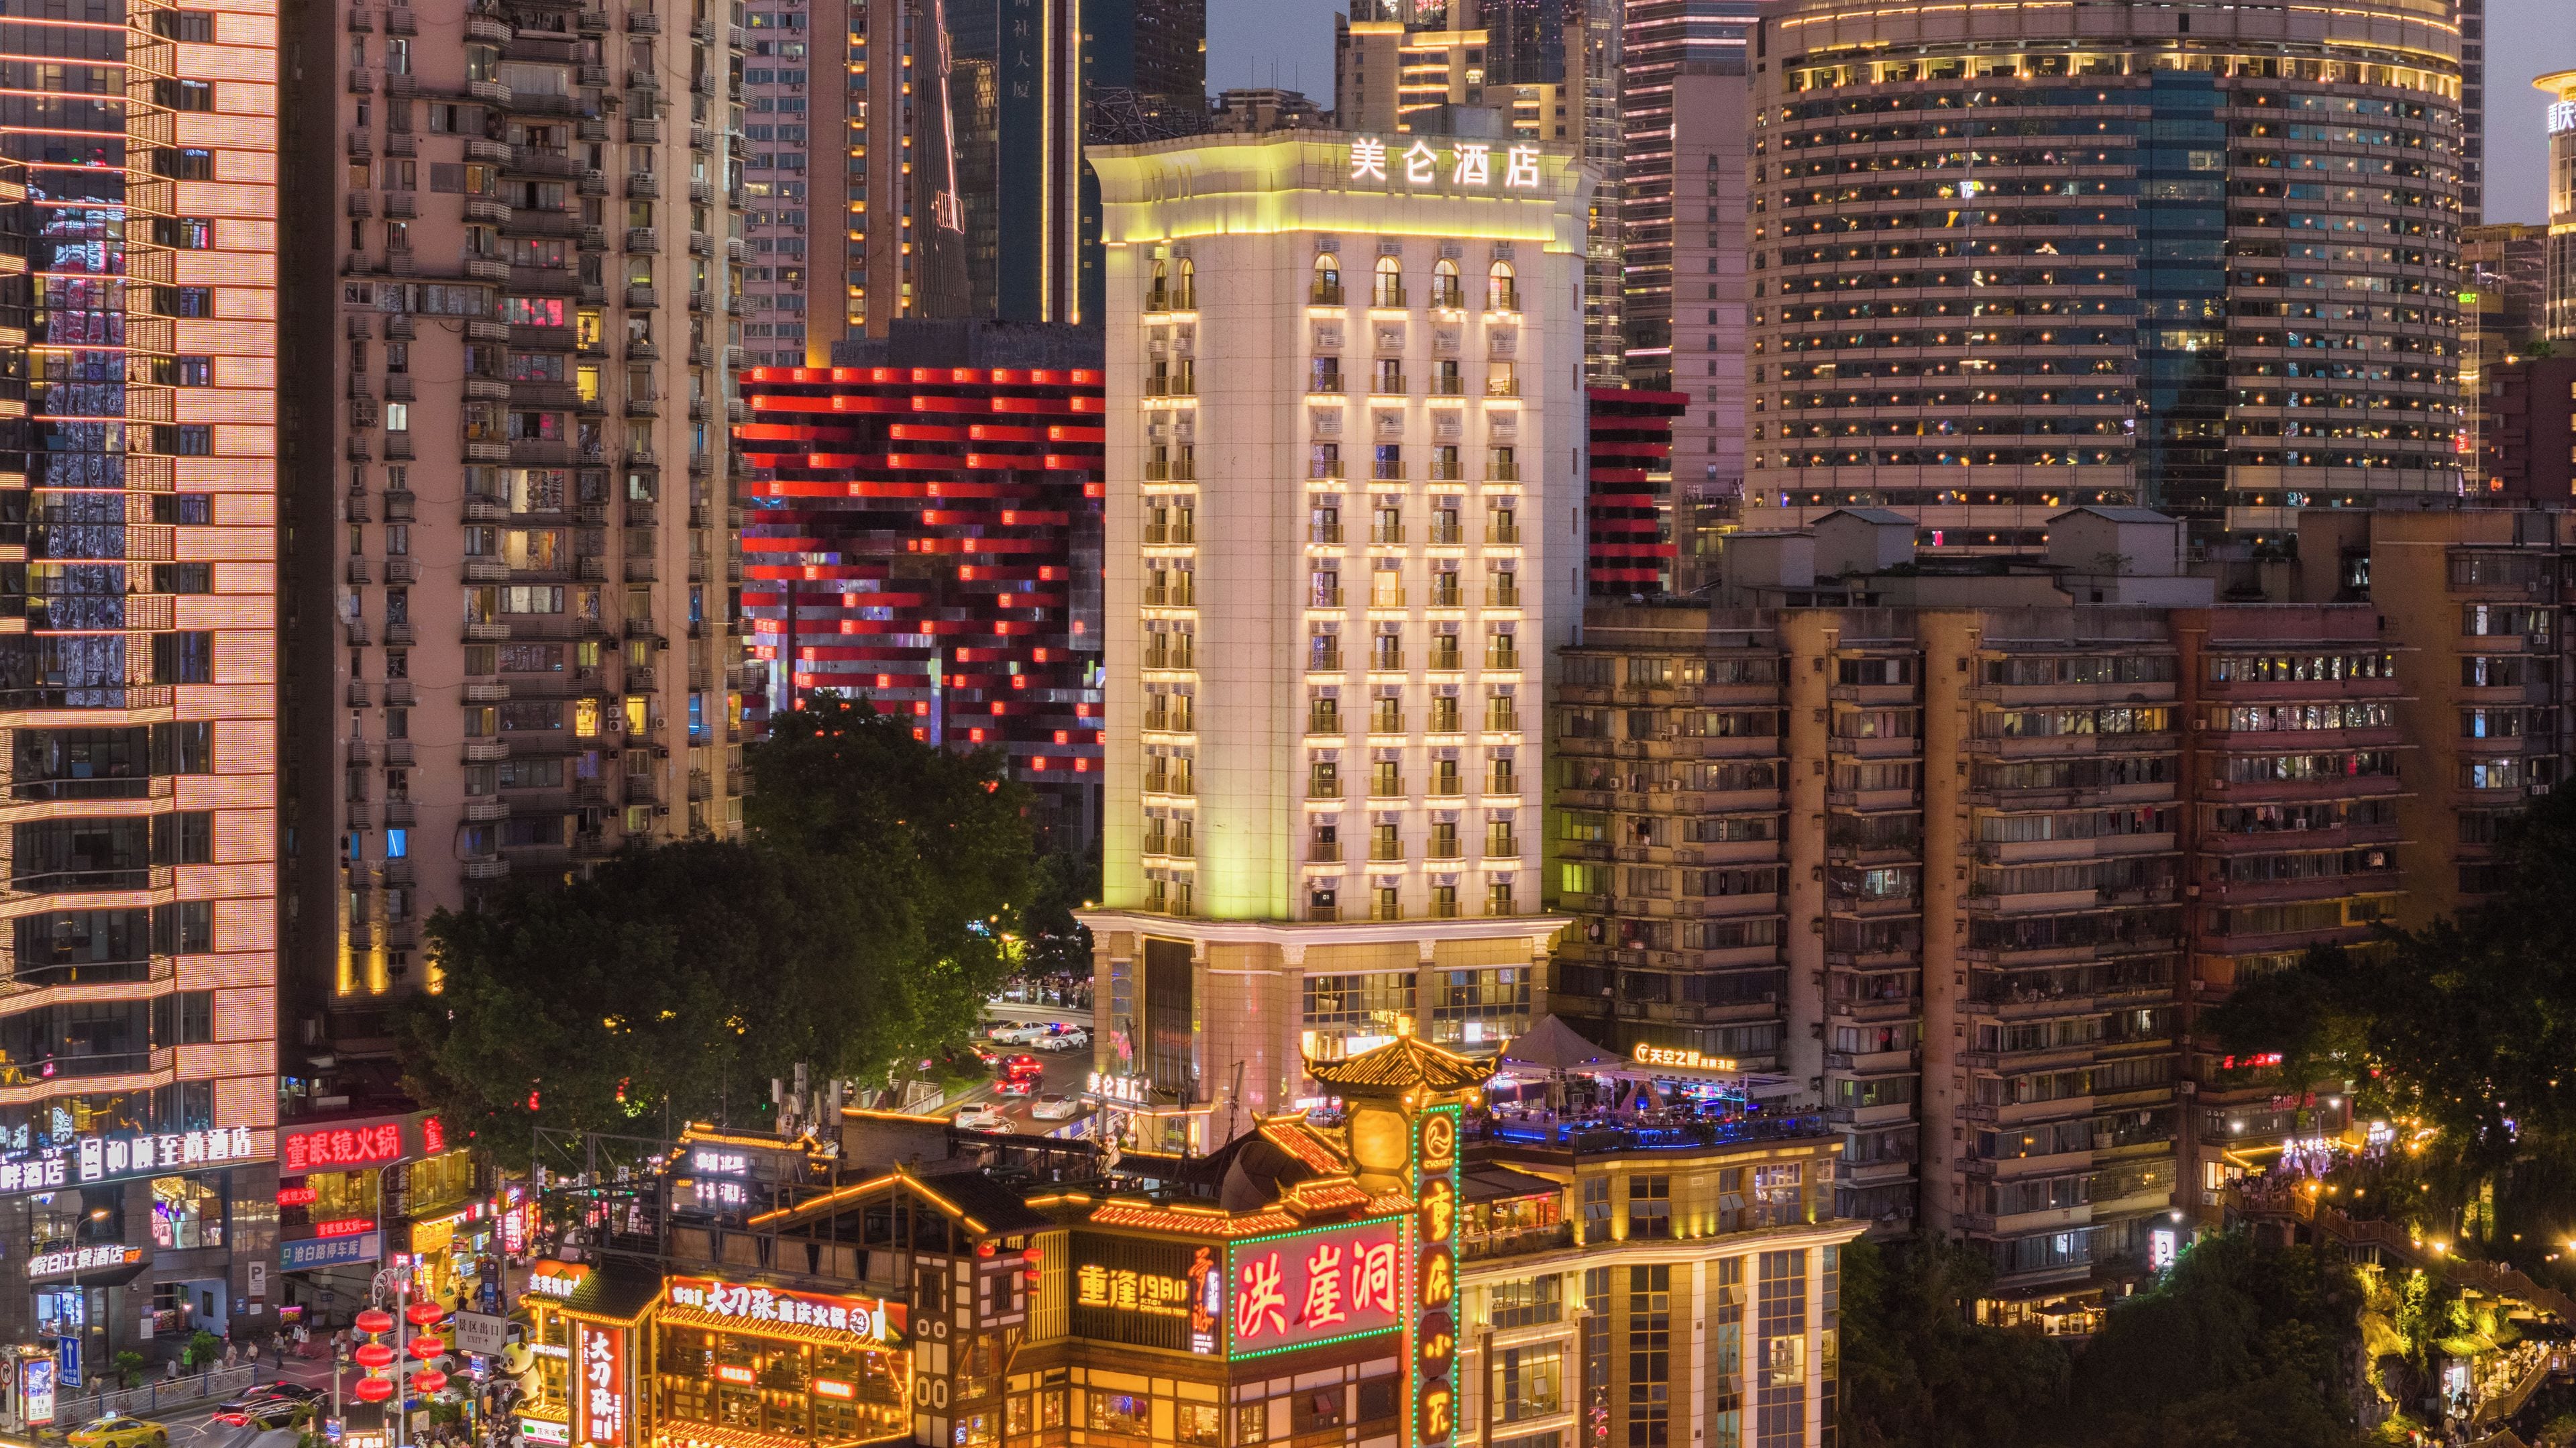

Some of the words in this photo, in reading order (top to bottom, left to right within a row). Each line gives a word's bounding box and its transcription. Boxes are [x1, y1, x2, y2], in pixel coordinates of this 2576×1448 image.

[2548, 101, 2576, 132] 重庆
[1350, 138, 1540, 187] 美仑酒店
[1650, 1049, 1699, 1066] 天空之眼
[287, 1125, 398, 1168] 董眼镜火锅
[1424, 1157, 1453, 1168] CYGNET
[278, 1188, 317, 1203] 眼镜火锅
[29, 1245, 125, 1275] 假日江景酒店
[294, 1241, 359, 1263] 沧白路停车库
[1238, 1241, 1395, 1337] 洪崖洞
[705, 1282, 778, 1321] 大刀张
[779, 1300, 846, 1331] 重庆火锅
[458, 1318, 499, 1337] 景区出口
[467, 1335, 482, 1343] EXIT
[588, 1331, 614, 1416] 大刀张
[32, 1406, 50, 1415] 卫生间
